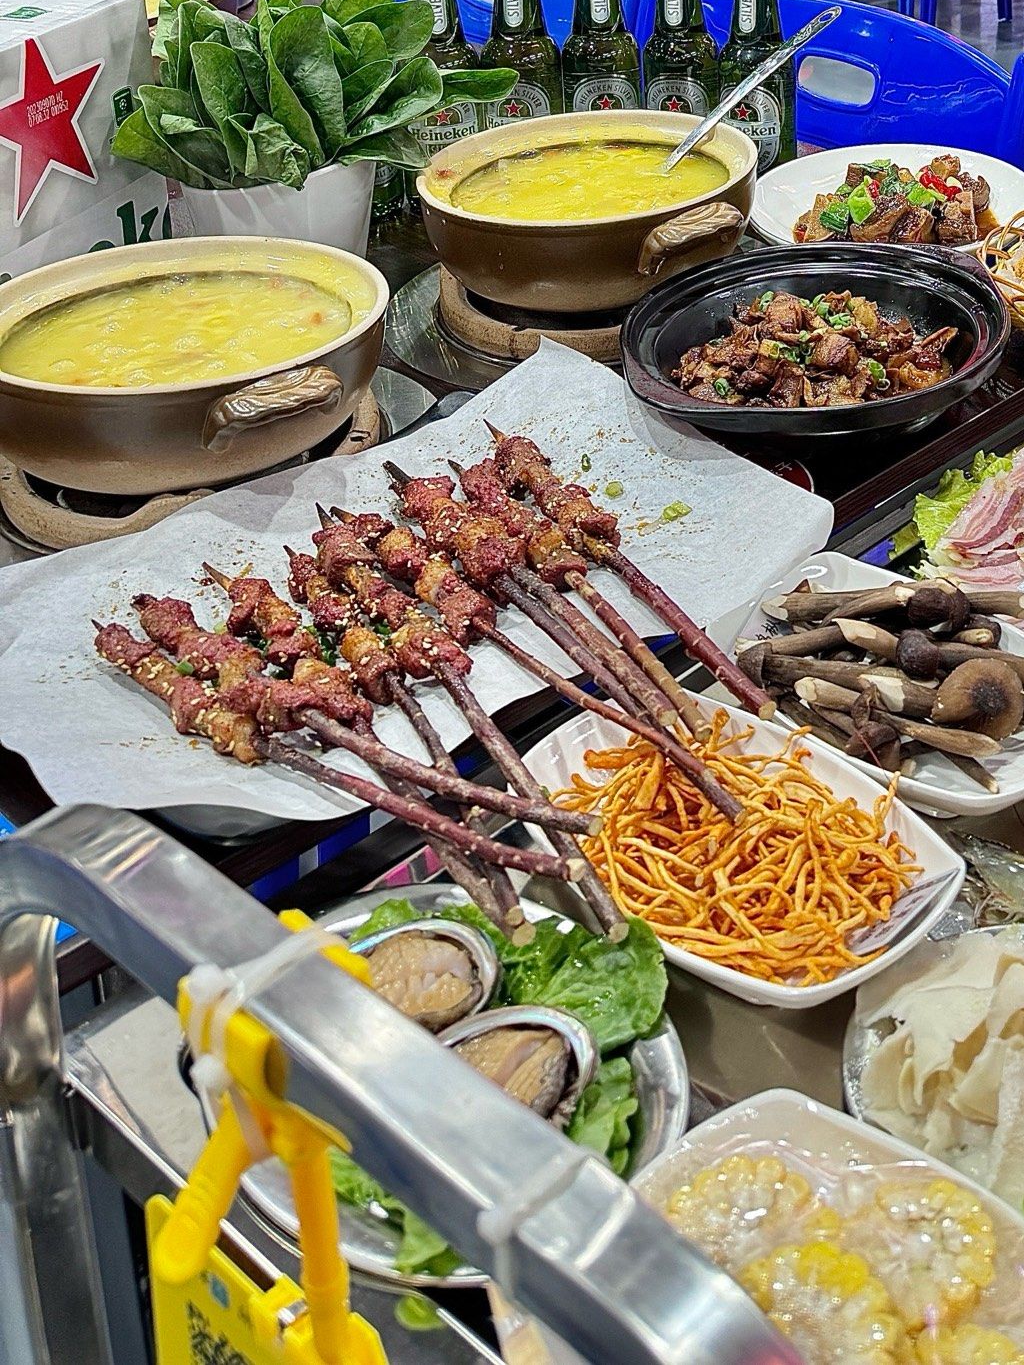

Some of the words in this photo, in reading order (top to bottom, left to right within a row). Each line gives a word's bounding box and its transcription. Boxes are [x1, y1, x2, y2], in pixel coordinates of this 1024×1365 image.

[522, 89, 542, 108] SILVER
[580, 84, 613, 104] HEINEKEN
[651, 85, 681, 103] HEINEKEN
[682, 86, 702, 104] SILVER
[751, 96, 770, 113] SILVER
[411, 125, 475, 141] Heineken
